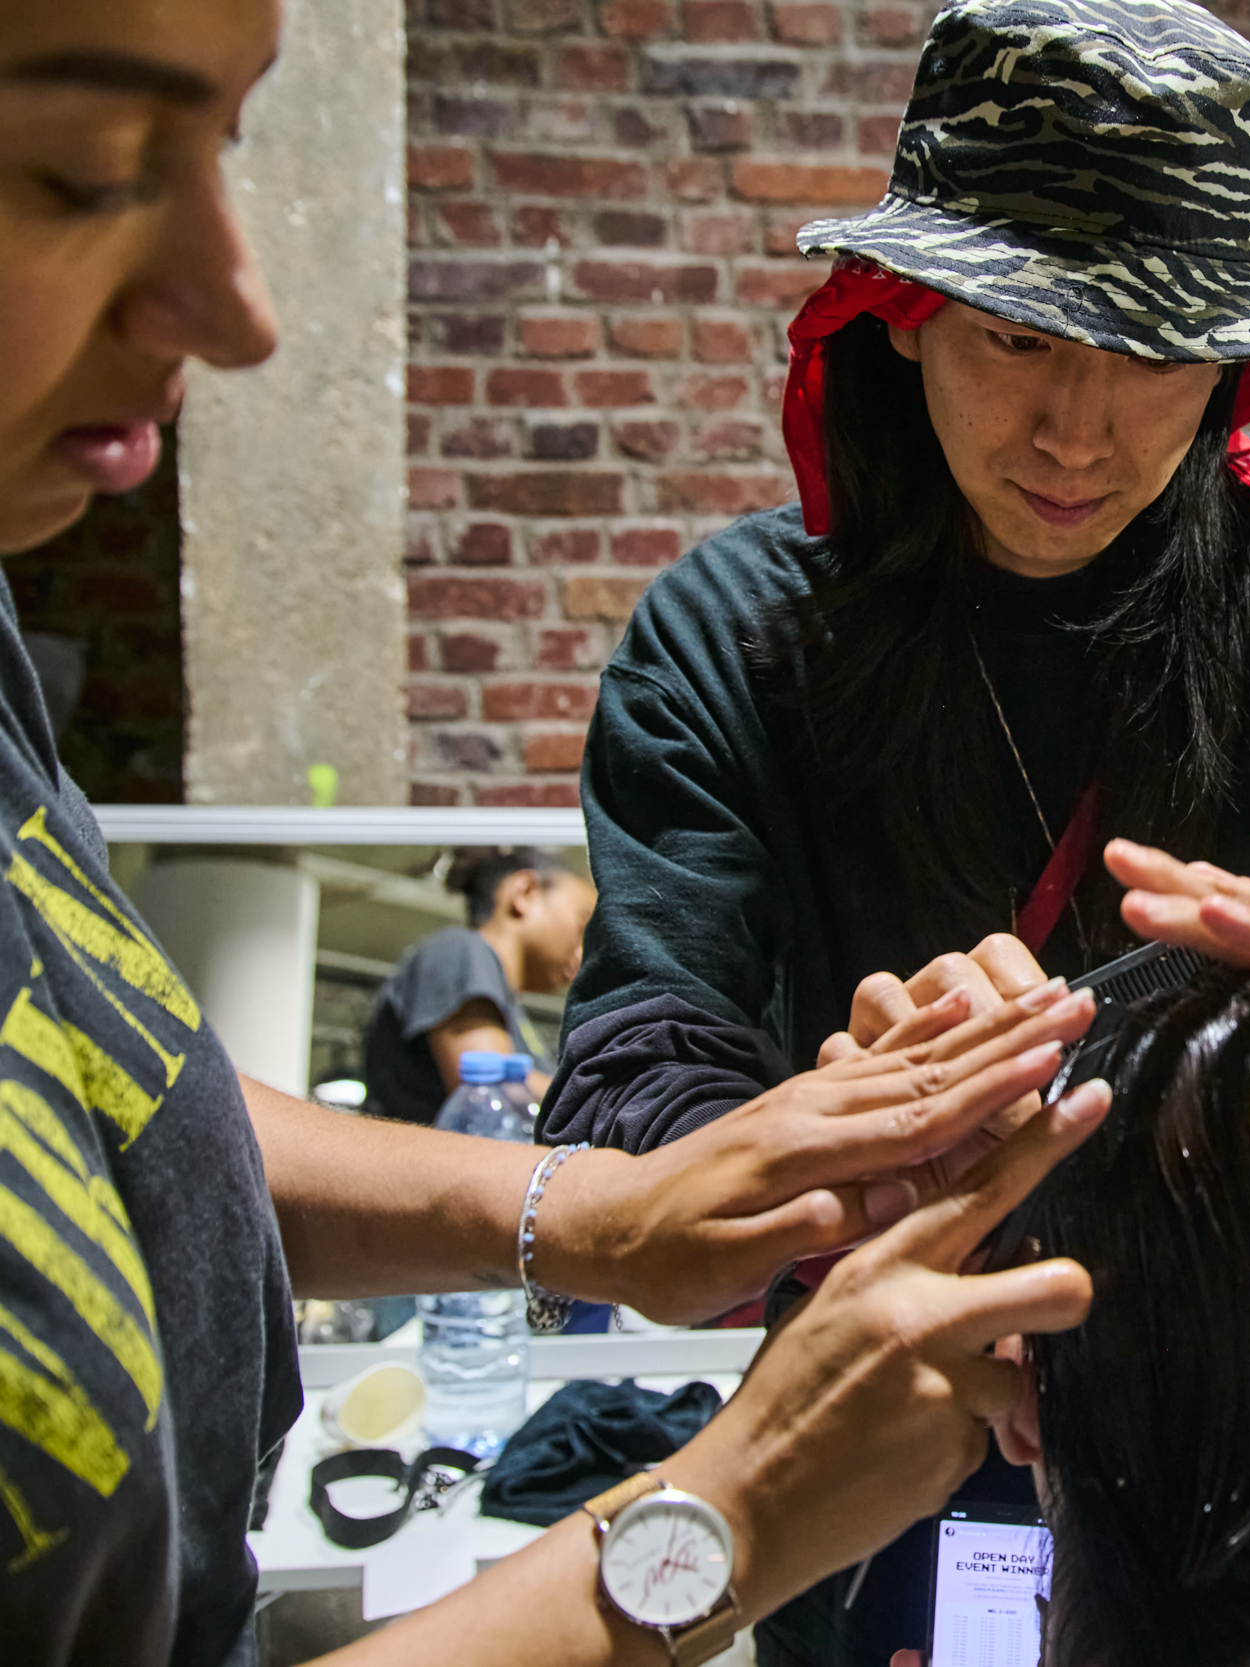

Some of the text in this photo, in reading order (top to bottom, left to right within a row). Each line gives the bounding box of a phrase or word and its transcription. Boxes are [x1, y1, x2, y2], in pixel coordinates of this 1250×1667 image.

[973, 1552, 1035, 1564] OPEN DAY
[956, 1562, 1051, 1576] EVENT WINNER
